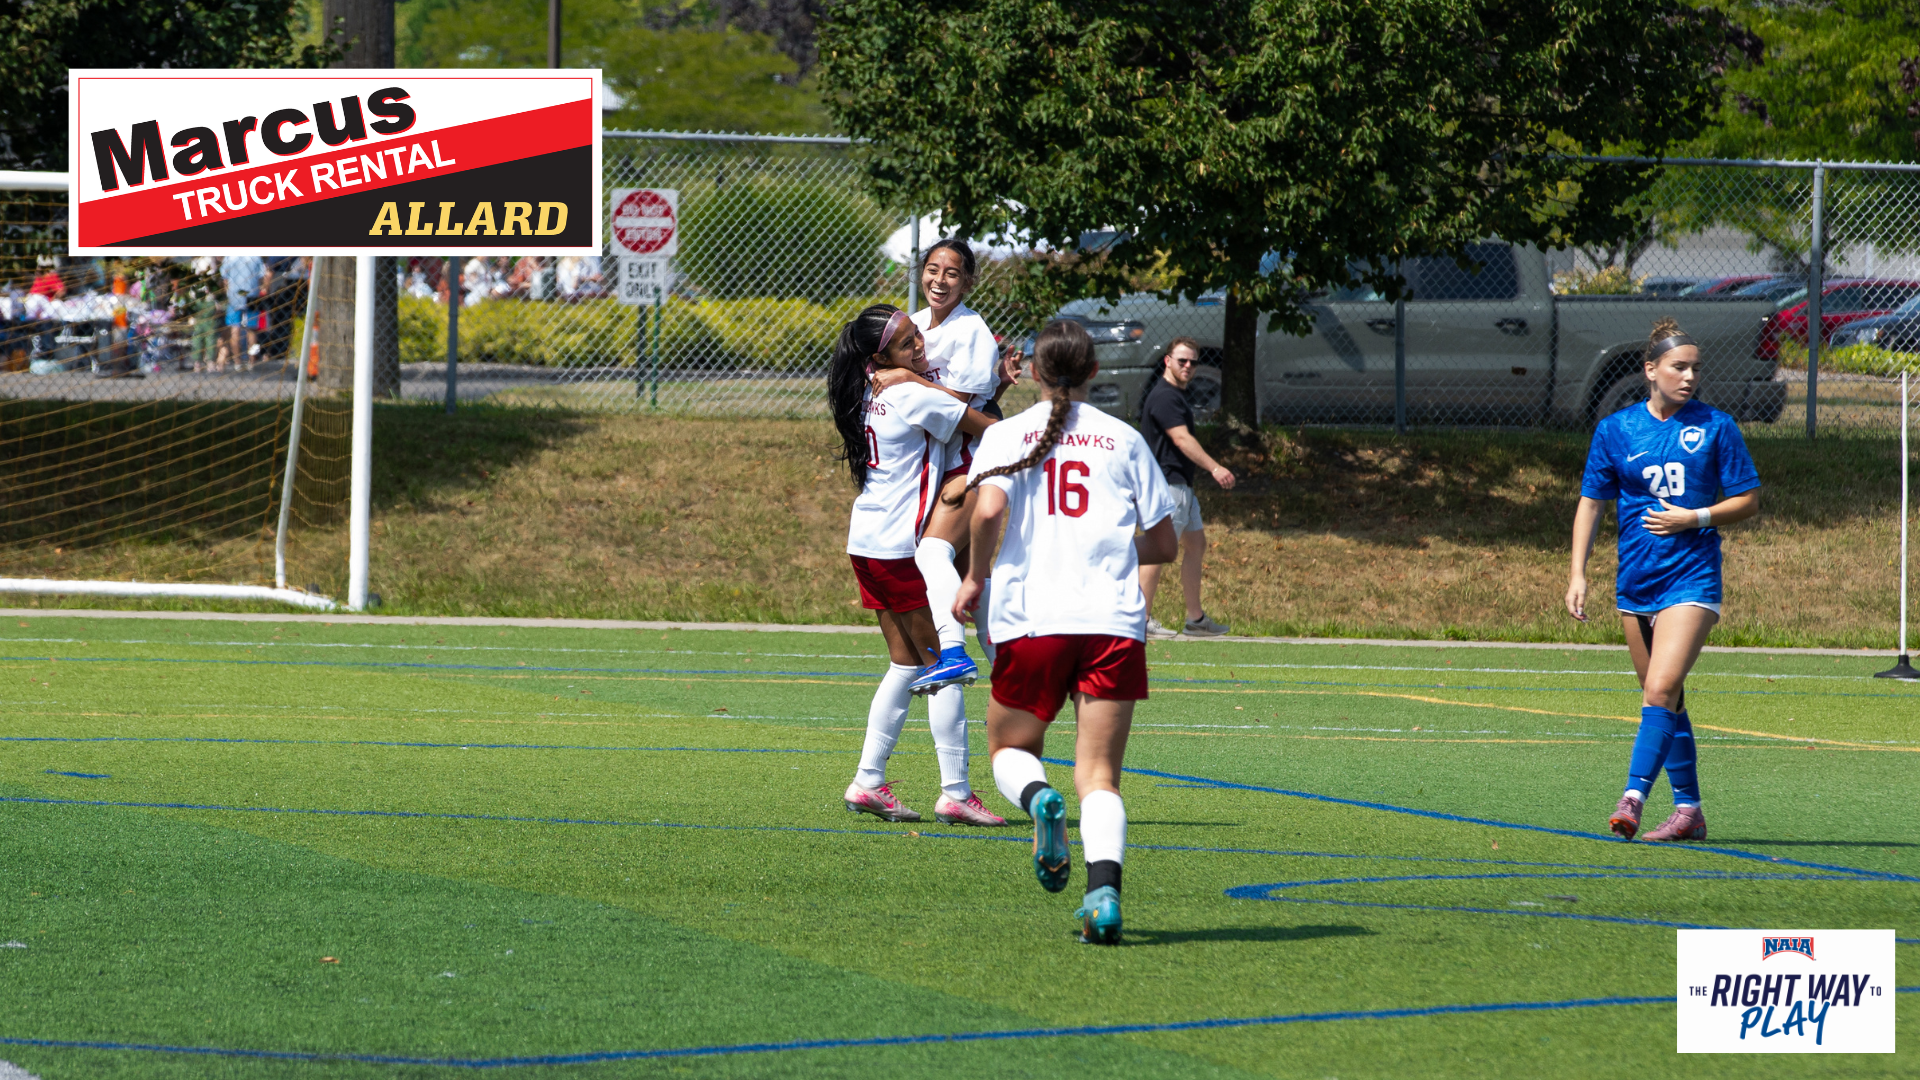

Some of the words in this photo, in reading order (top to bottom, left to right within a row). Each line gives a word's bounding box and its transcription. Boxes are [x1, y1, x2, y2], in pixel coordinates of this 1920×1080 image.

[628, 262, 657, 279] EXIT
[1024, 429, 1115, 451] REHAWKS
[1043, 457, 1090, 518] 16
[1642, 462, 1685, 498] 28
